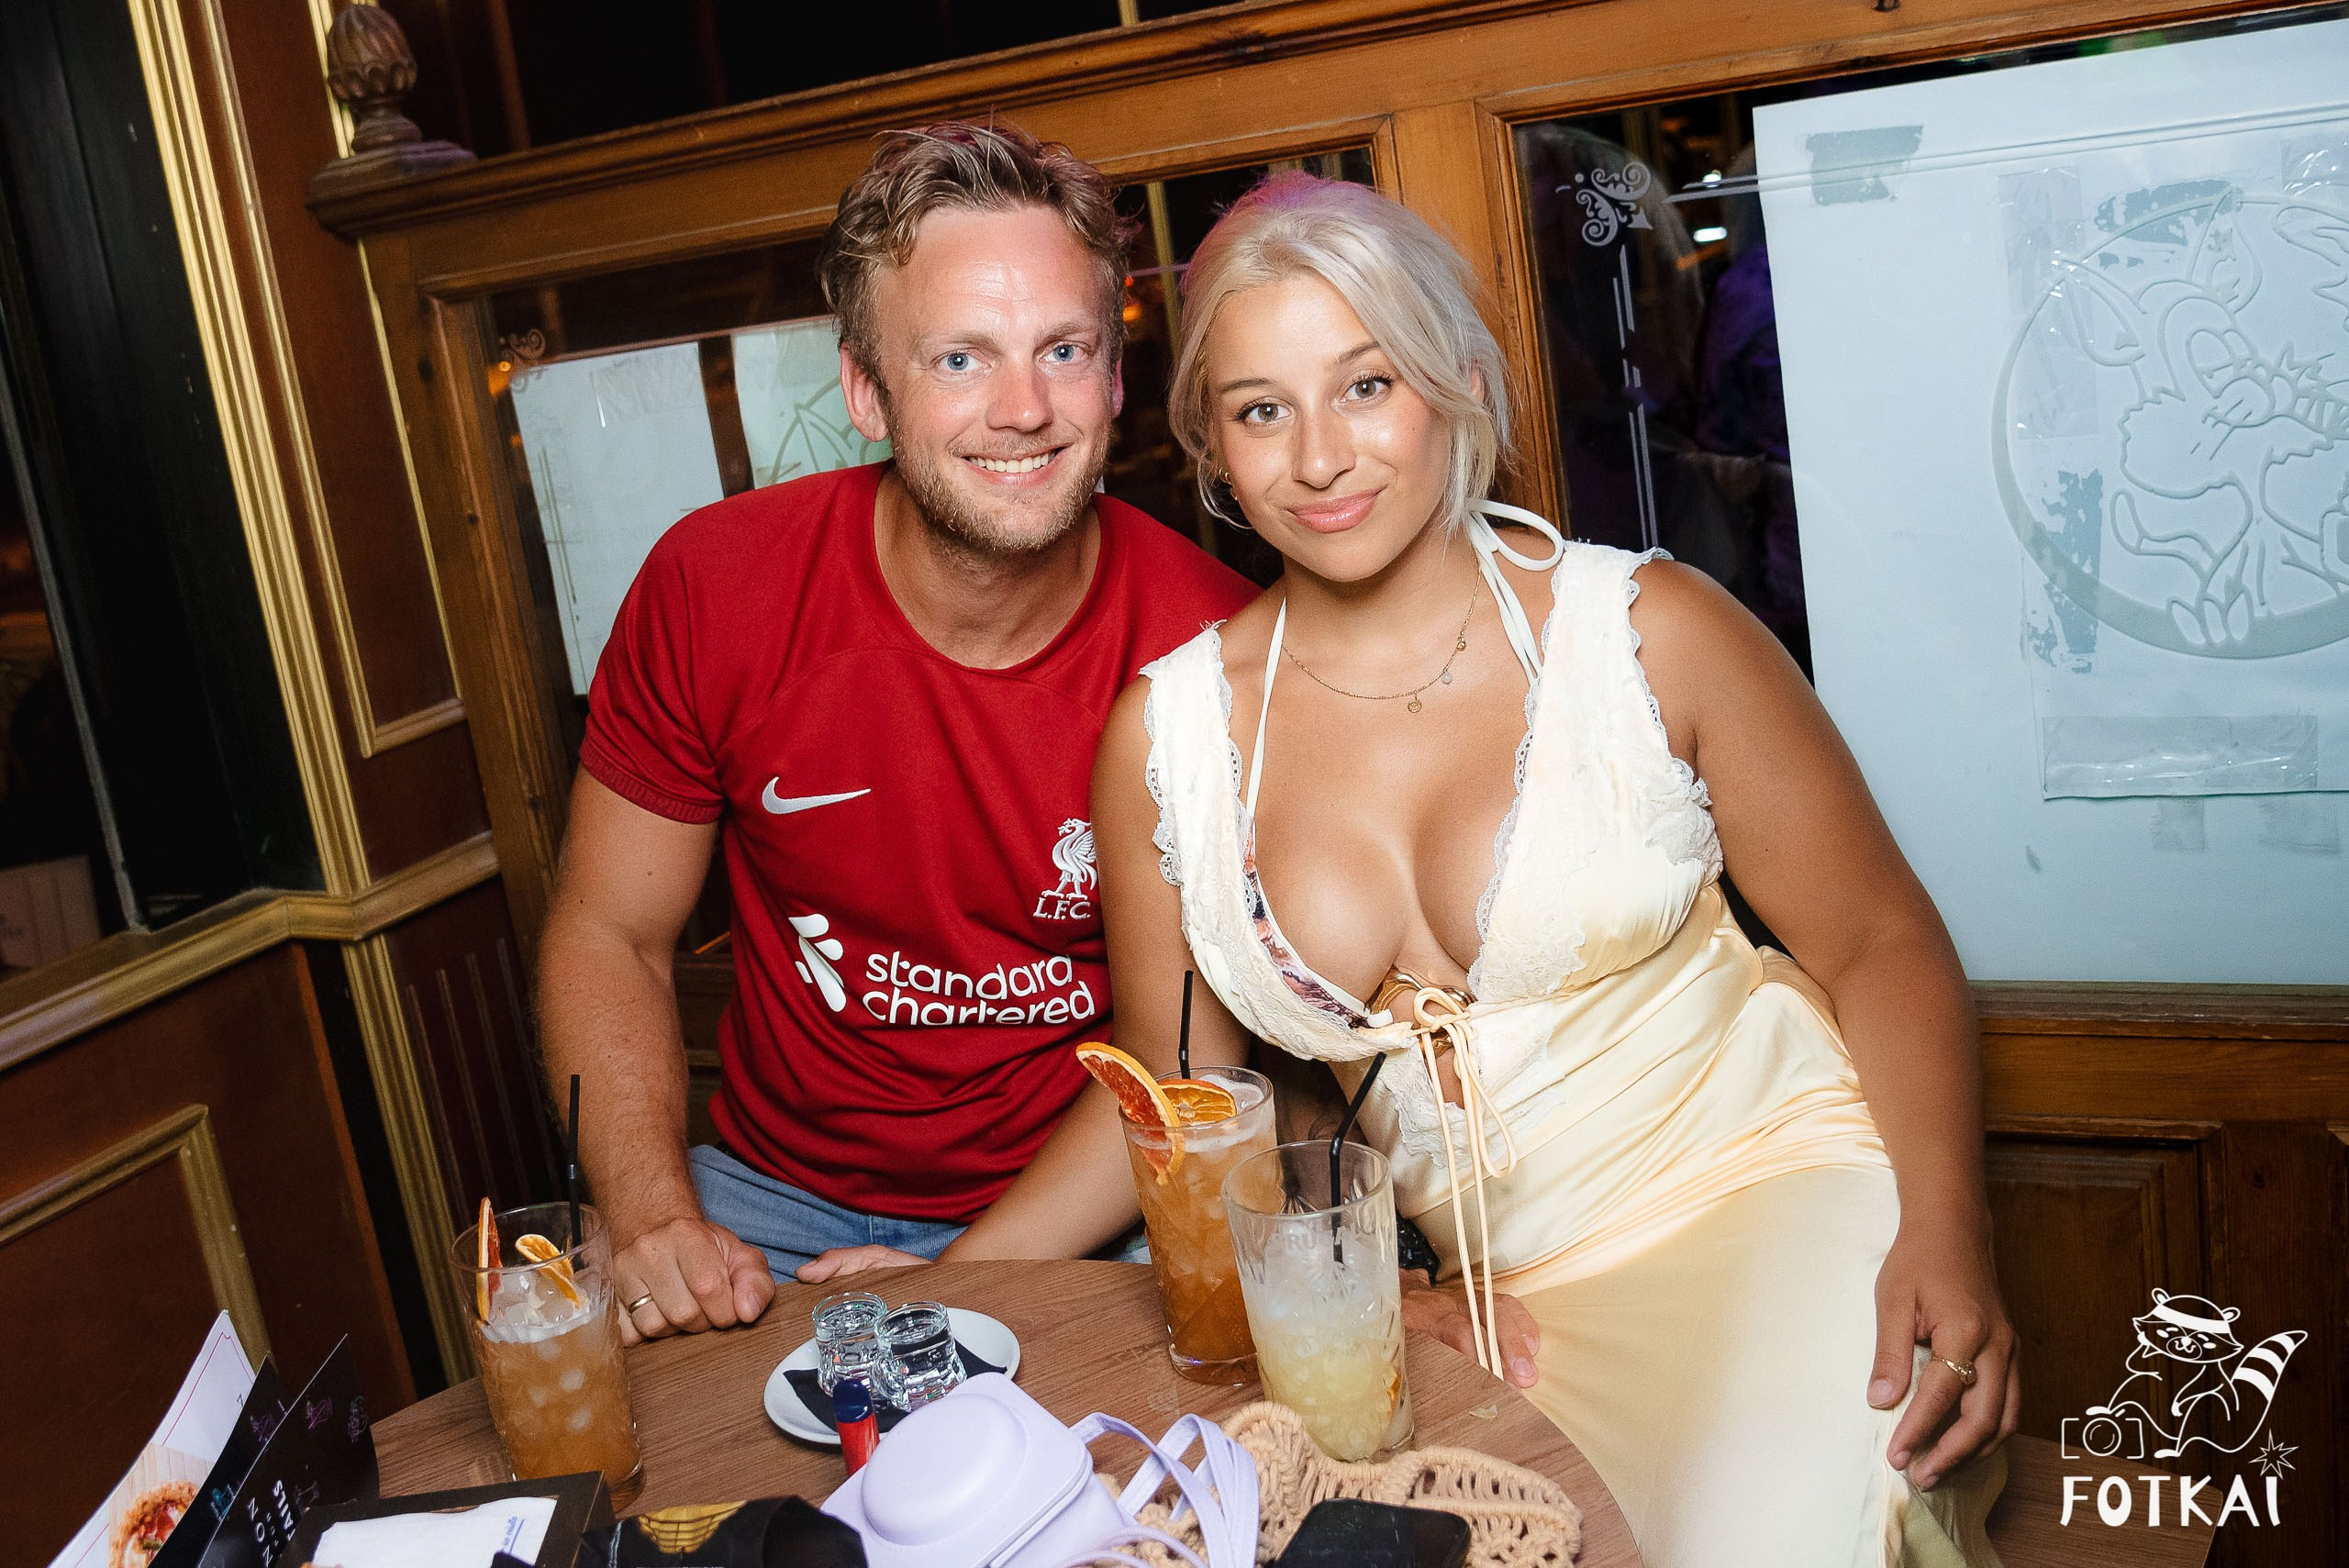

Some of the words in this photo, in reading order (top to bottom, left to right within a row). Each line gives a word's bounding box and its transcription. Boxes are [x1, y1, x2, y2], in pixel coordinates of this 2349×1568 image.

[1033, 897, 1091, 920] L.F.C.
[866, 951, 1073, 1000] standard
[863, 981, 1096, 1026] chartered
